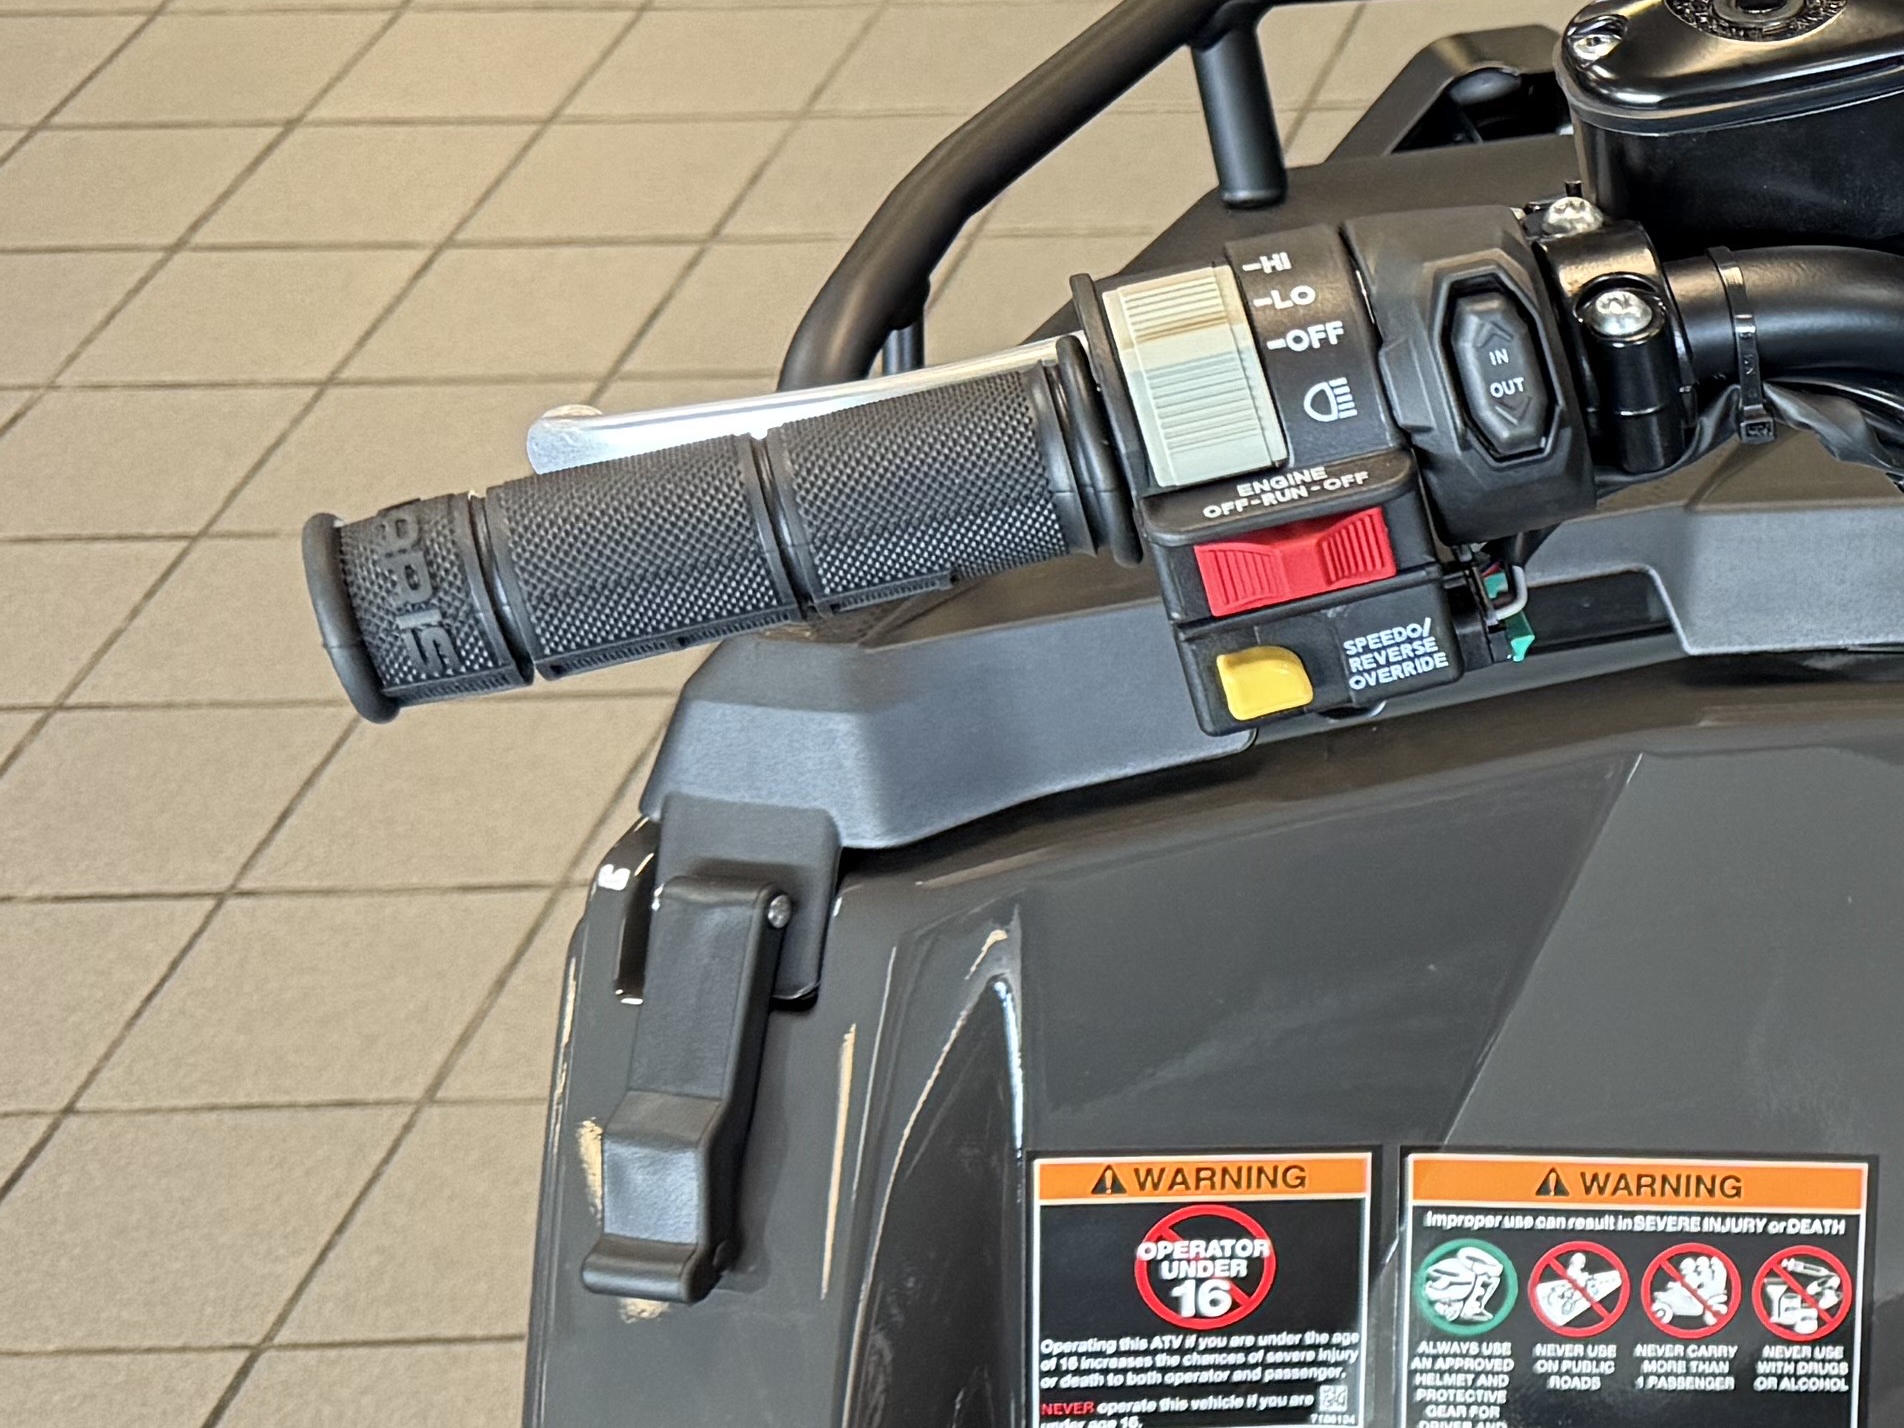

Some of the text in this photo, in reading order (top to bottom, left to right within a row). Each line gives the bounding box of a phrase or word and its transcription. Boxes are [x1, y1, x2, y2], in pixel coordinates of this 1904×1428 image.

[1489, 348, 1509, 366] IN
[1489, 376, 1524, 398] OUT
[1235, 465, 1329, 498] ENGINE
[1343, 616, 1435, 656] SPEEDO/
[1345, 636, 1441, 673] REVERSE
[1347, 650, 1449, 690] OVERRIDE
[1133, 1164, 1306, 1191] WARNING
[1580, 1171, 1741, 1198] WARNING
[1424, 1209, 1846, 1235] Improper use can result in SEVERE INJURY or DEATH
[1136, 1238, 1270, 1260] OPERATOR
[1160, 1258, 1247, 1279] UNDER
[1171, 1279, 1231, 1317] 16
